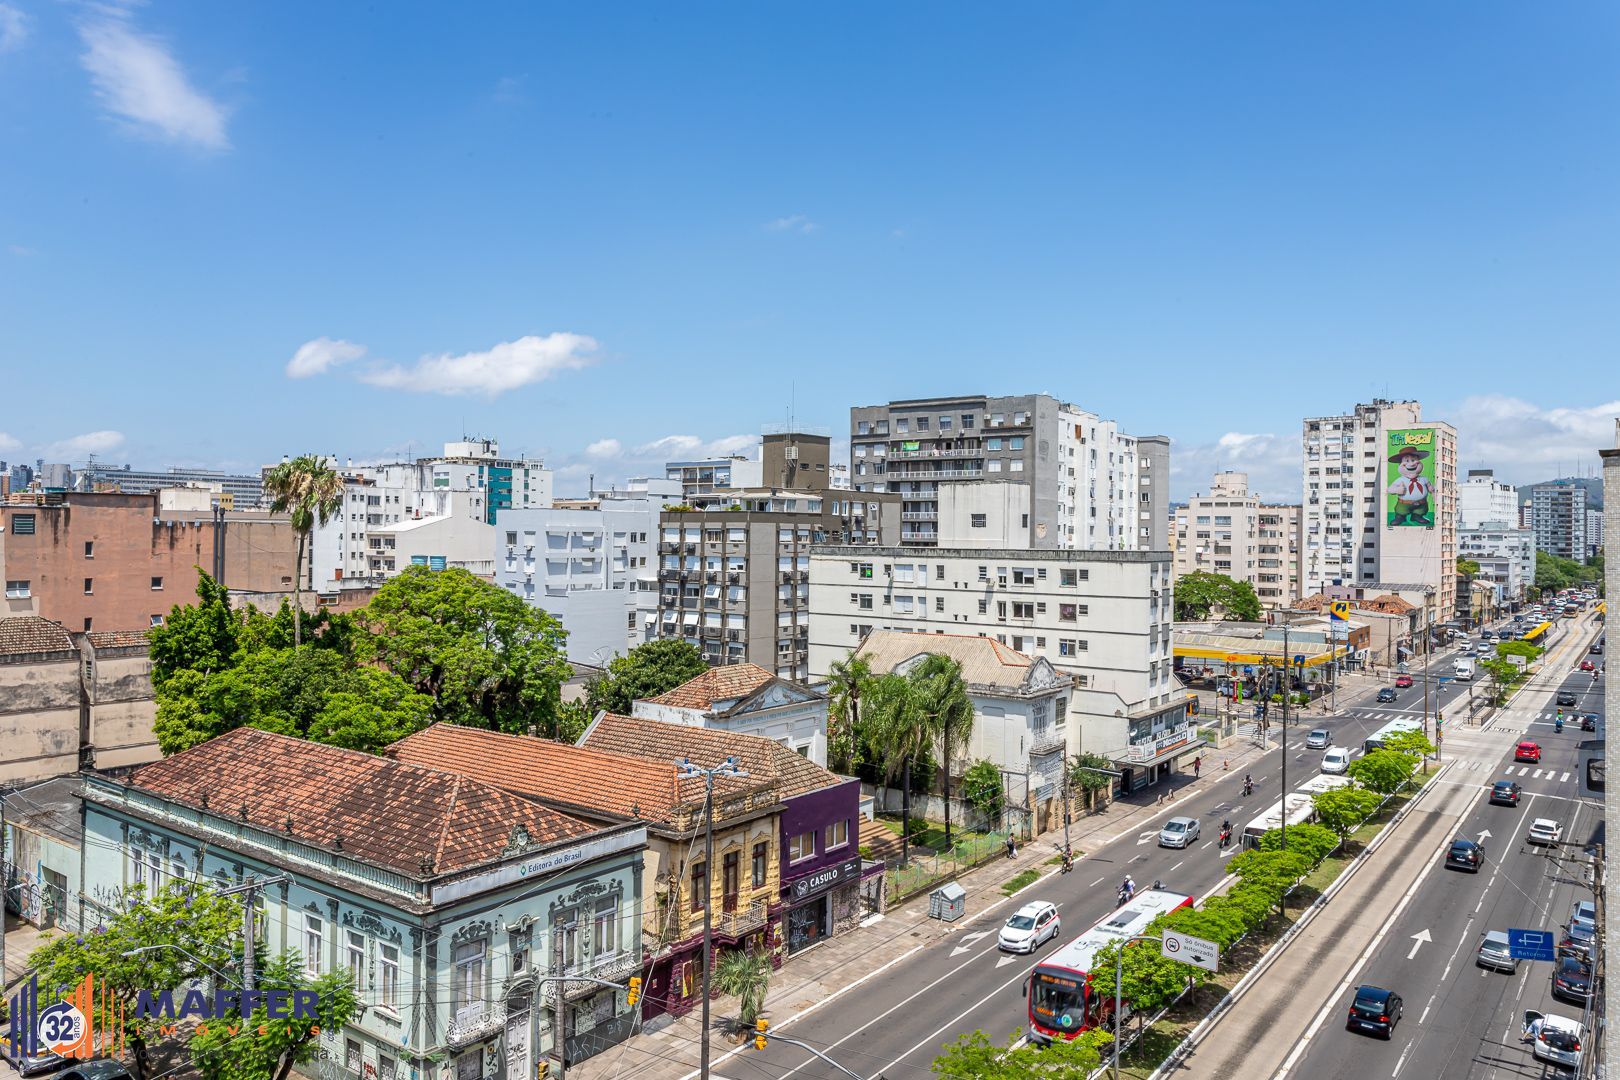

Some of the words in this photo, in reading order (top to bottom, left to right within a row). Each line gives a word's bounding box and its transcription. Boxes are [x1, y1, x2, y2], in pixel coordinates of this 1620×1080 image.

[528, 861, 552, 873] Editora
[554, 857, 563, 865] do
[564, 851, 582, 862] Brasil
[810, 869, 838, 887] CASULO
[1183, 946, 1213, 957] autorizado
[1194, 941, 1213, 951] ônibus
